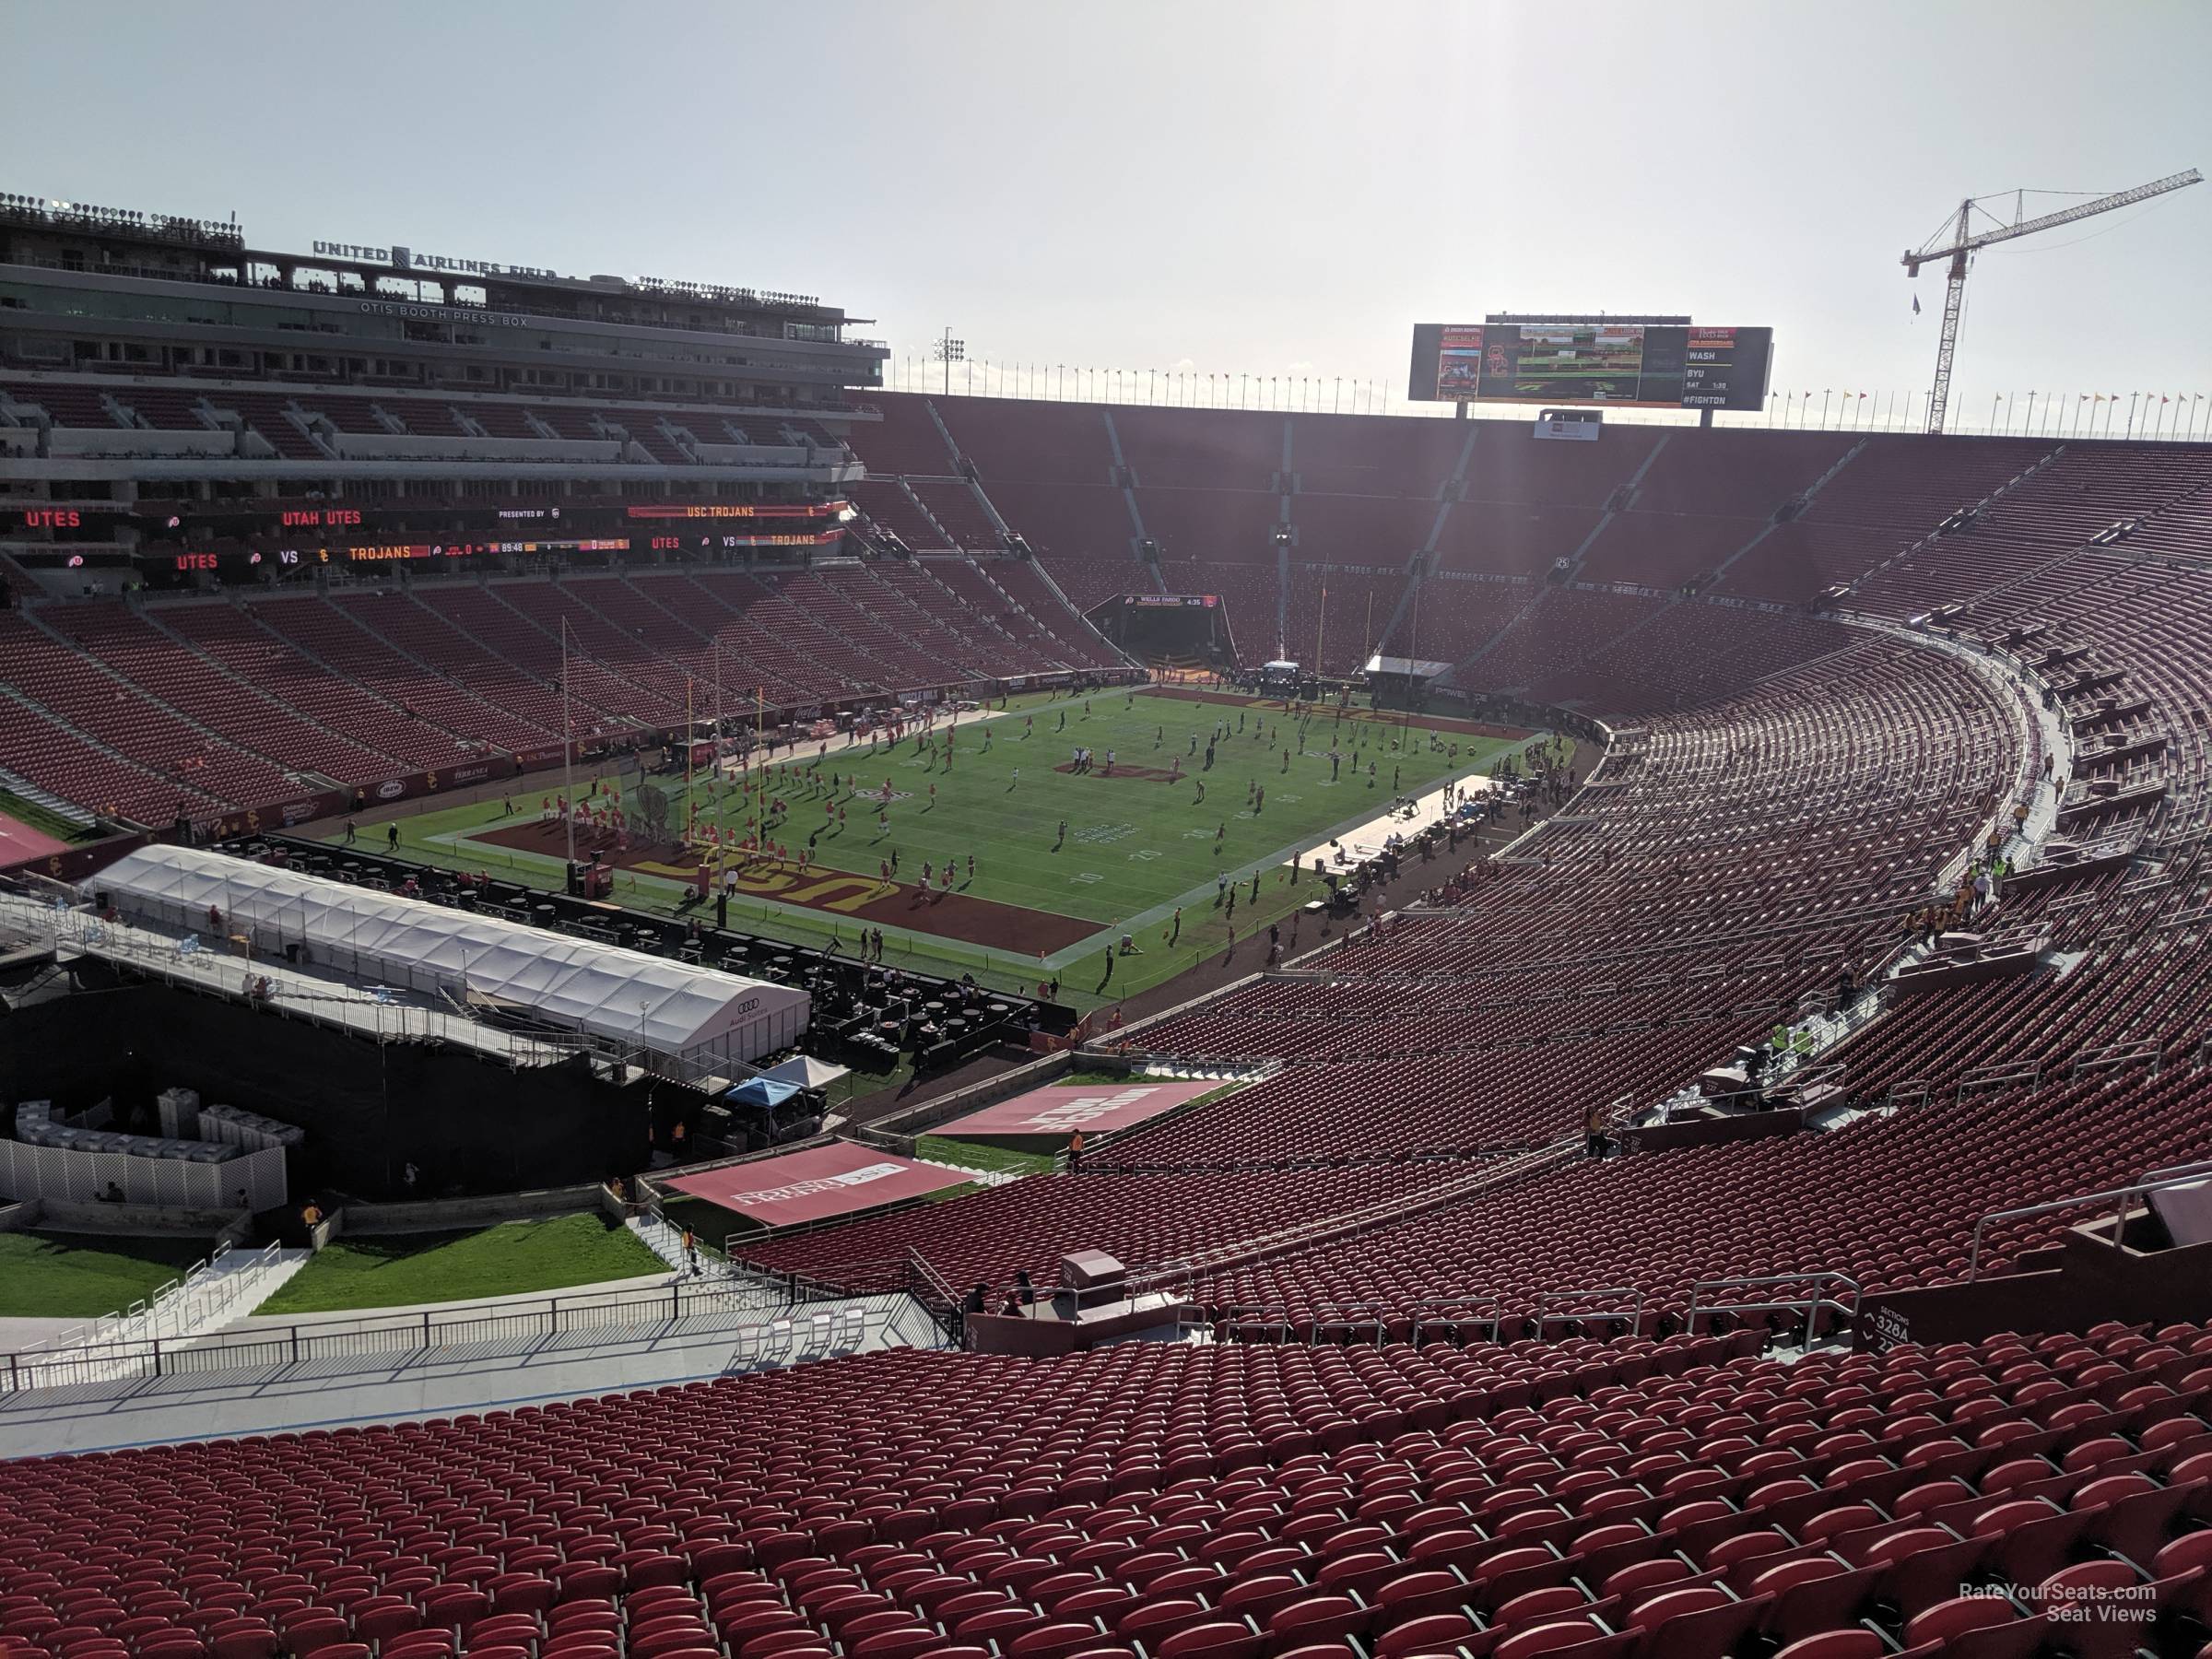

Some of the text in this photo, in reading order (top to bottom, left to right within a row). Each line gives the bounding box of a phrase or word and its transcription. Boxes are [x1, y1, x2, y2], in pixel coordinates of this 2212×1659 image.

[312, 241, 557, 281] UNITED AIRLINES FIELD
[360, 302, 528, 326] OTIS BOOTH PRESS BOX
[1689, 352, 1715, 360] WASH
[1688, 370, 1704, 378] BYU
[1683, 395, 1725, 405] #FIGHTON
[499, 510, 545, 519] PRESENTED BY
[688, 507, 754, 517] USC TROJANS
[27, 512, 80, 527] UTES
[283, 511, 361, 525] UTAH UTES
[652, 537, 679, 549] UTES
[724, 537, 735, 547] VS
[771, 535, 815, 546] TROJANS
[501, 543, 523, 552] 89:48
[280, 550, 299, 564] VS
[349, 546, 411, 560] TROJANS
[177, 553, 218, 570] UTES
[1558, 559, 1567, 567] 25
[1128, 850, 1162, 861] 20
[1069, 873, 1104, 884] 10
[730, 1016, 747, 1027] Audi
[1880, 1305, 1910, 1325] SECTIONS
[1877, 1315, 1909, 1343] 328A
